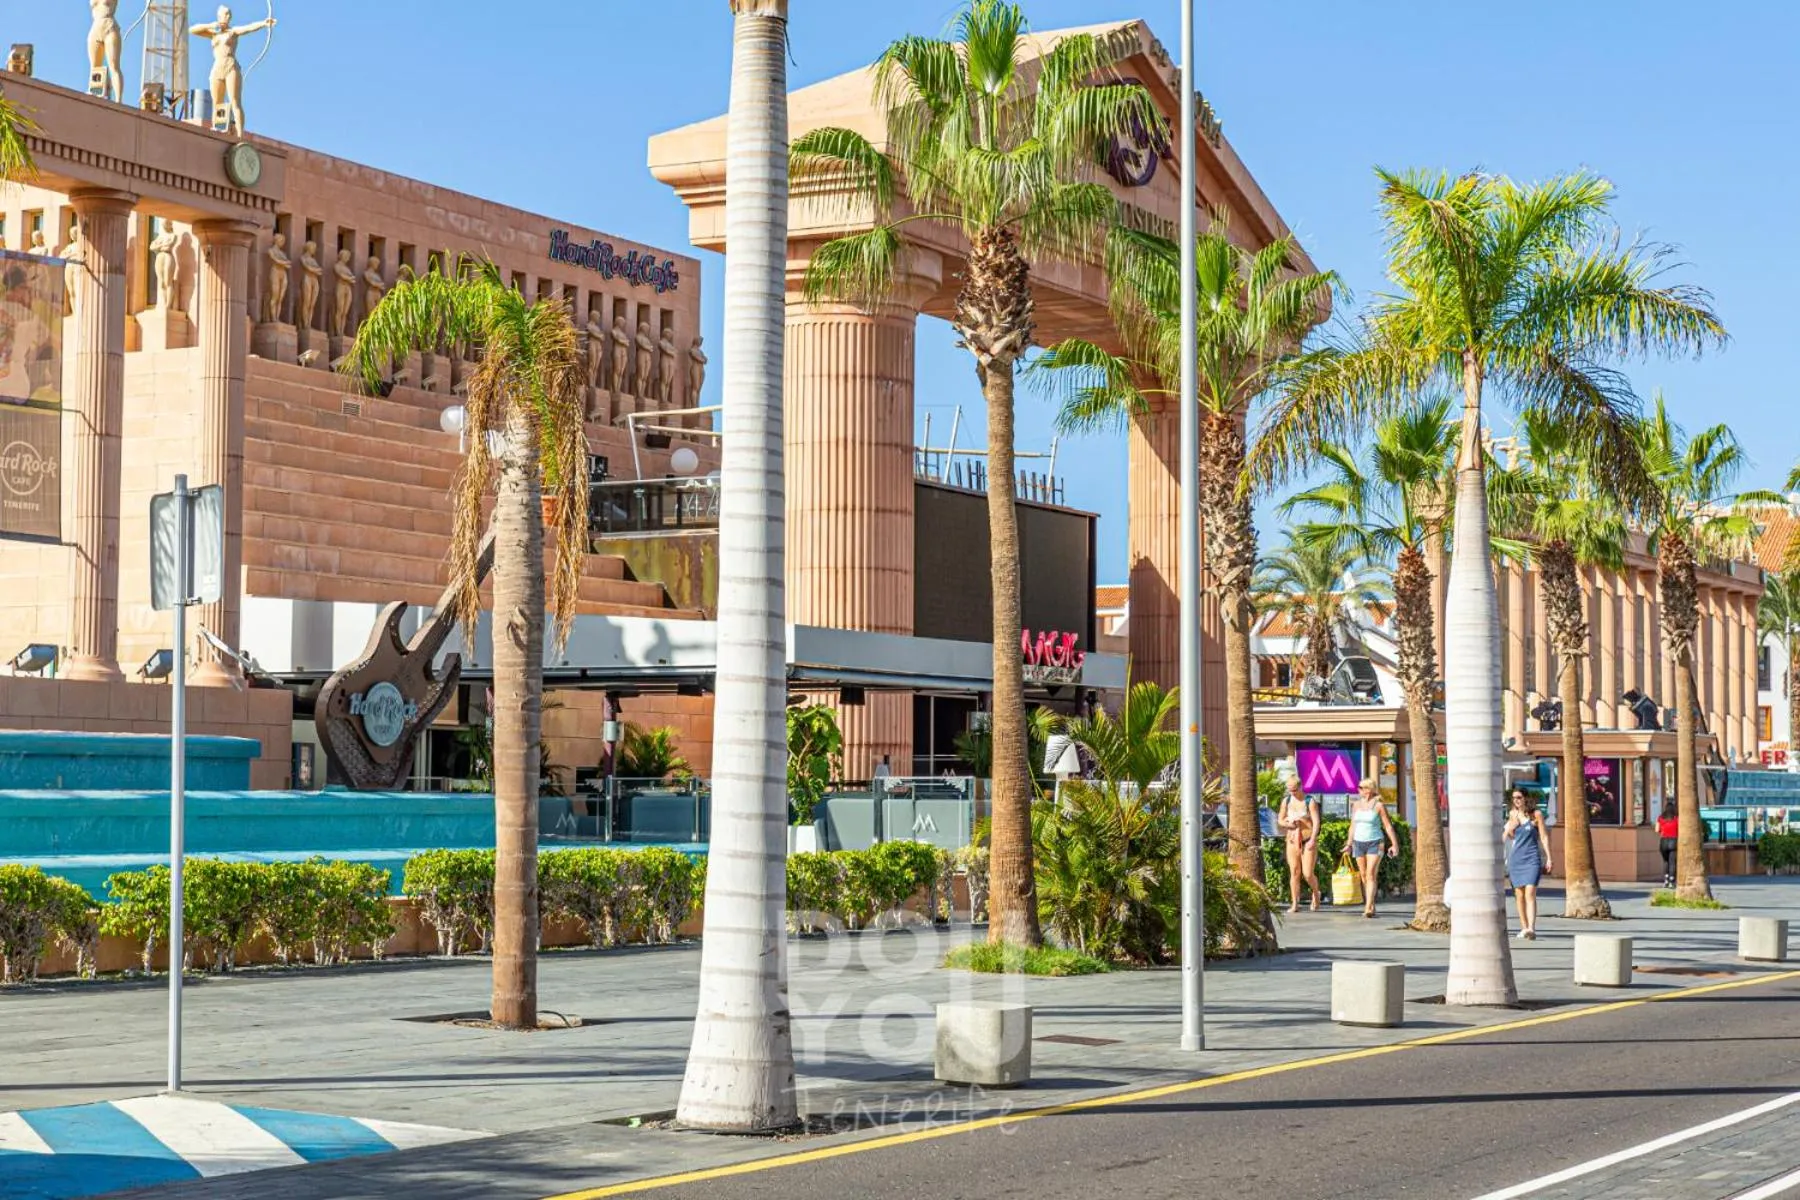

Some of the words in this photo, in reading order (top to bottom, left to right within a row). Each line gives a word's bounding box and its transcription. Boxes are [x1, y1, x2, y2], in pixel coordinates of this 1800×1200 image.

[550, 230, 601, 271] Hard
[599, 242, 642, 287] Rock
[640, 255, 679, 294] Cafe
[22, 453, 57, 478] Rock
[349, 692, 385, 716] Hard
